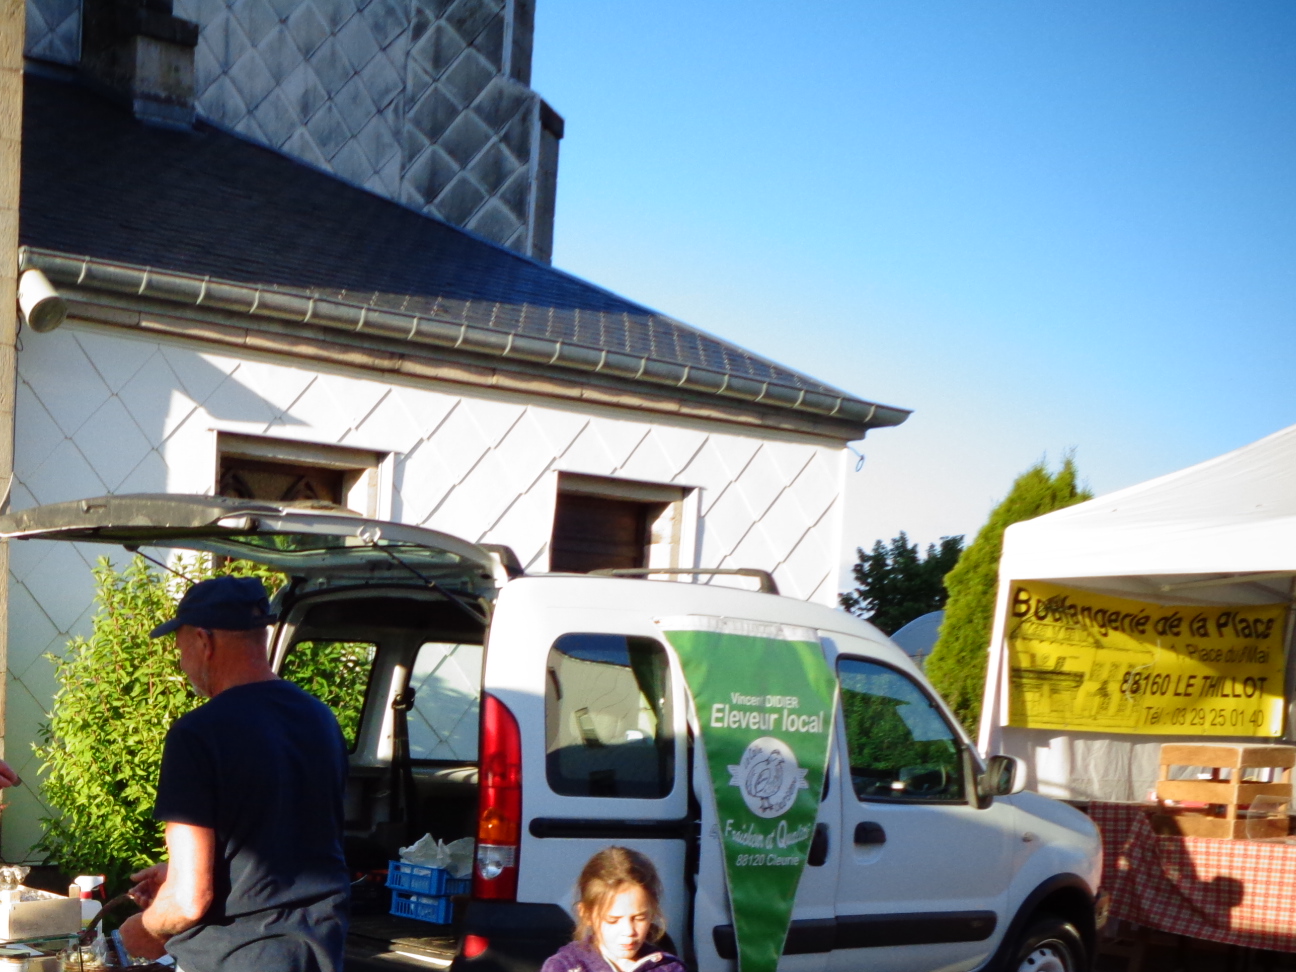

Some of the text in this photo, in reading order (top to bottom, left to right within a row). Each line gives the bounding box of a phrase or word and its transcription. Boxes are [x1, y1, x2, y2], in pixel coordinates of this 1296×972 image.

[1012, 587, 1275, 639] Boulangerie de la Place
[1186, 644, 1223, 663] Place
[1120, 671, 1268, 698] 88160 LE THILLOT
[765, 695, 799, 708] DIDIER
[710, 703, 824, 733] Eleveur local
[1171, 707, 1187, 726] 03
[1190, 708, 1206, 726] 29
[1210, 708, 1226, 727] 25
[1230, 708, 1245, 727] 01
[1249, 709, 1265, 728] 40
[735, 854, 800, 867] 88120 Cleurie
